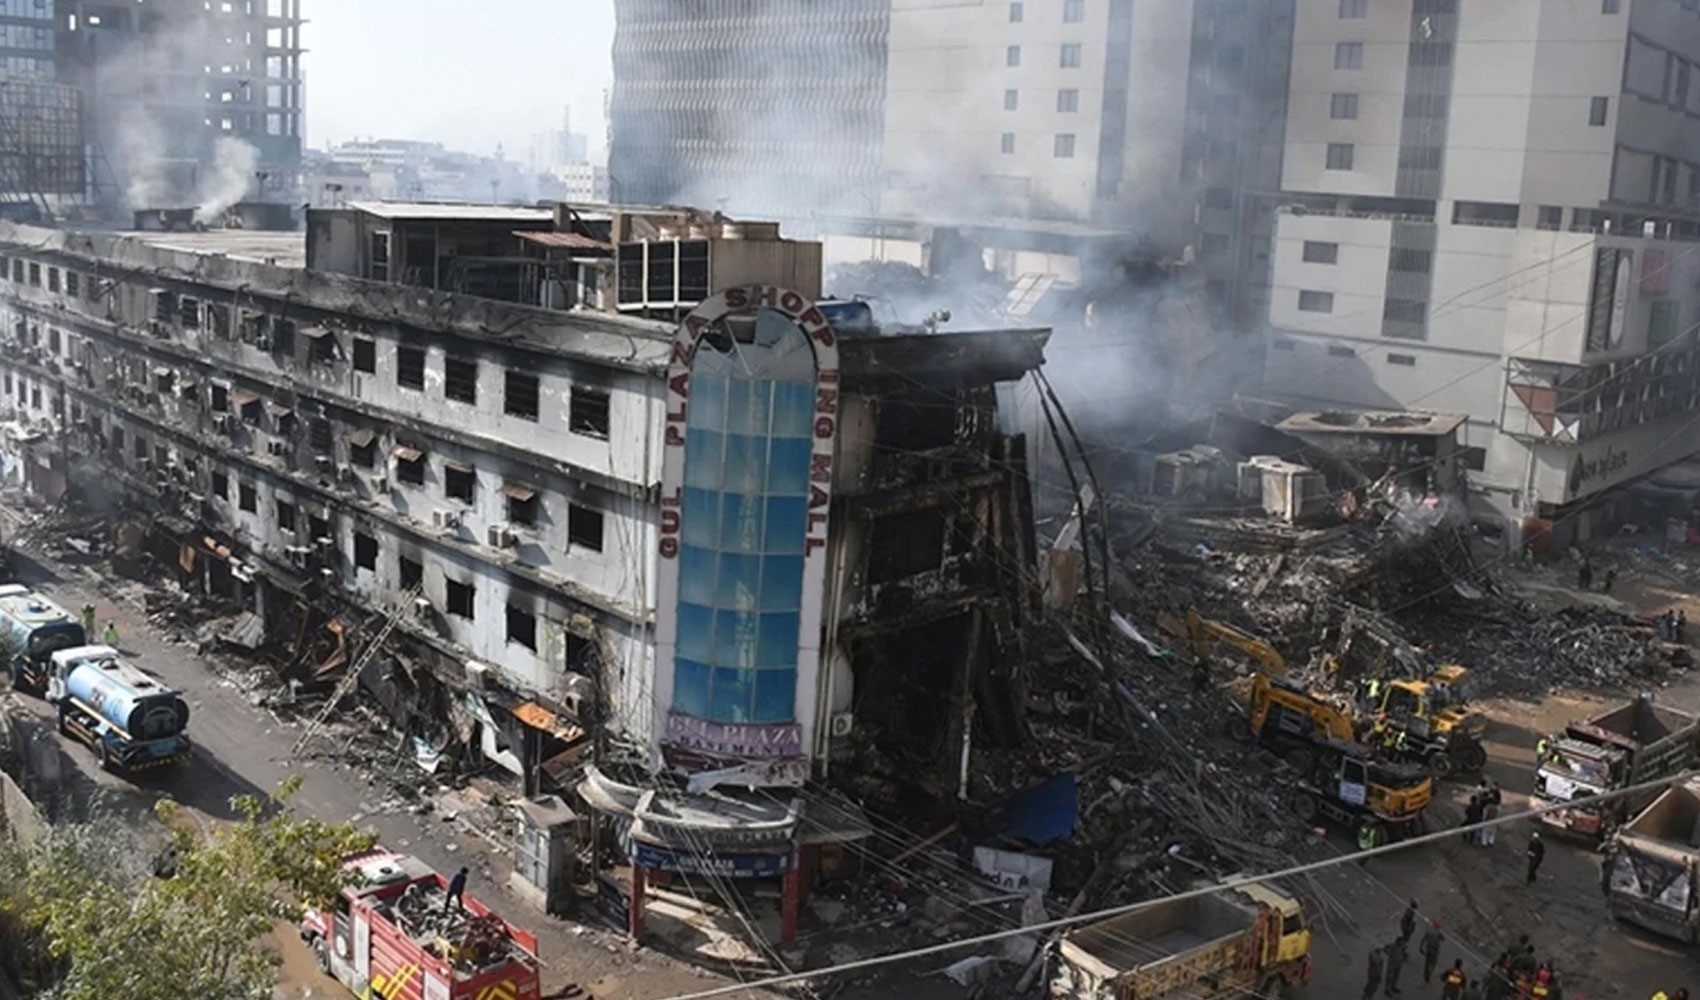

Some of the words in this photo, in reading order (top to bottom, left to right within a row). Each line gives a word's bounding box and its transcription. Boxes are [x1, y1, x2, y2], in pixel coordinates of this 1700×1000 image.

[665, 314, 709, 446] PLAZA
[658, 487, 681, 559] GUL
[805, 453, 832, 558] MALL
[722, 725, 800, 744] PLAZA
